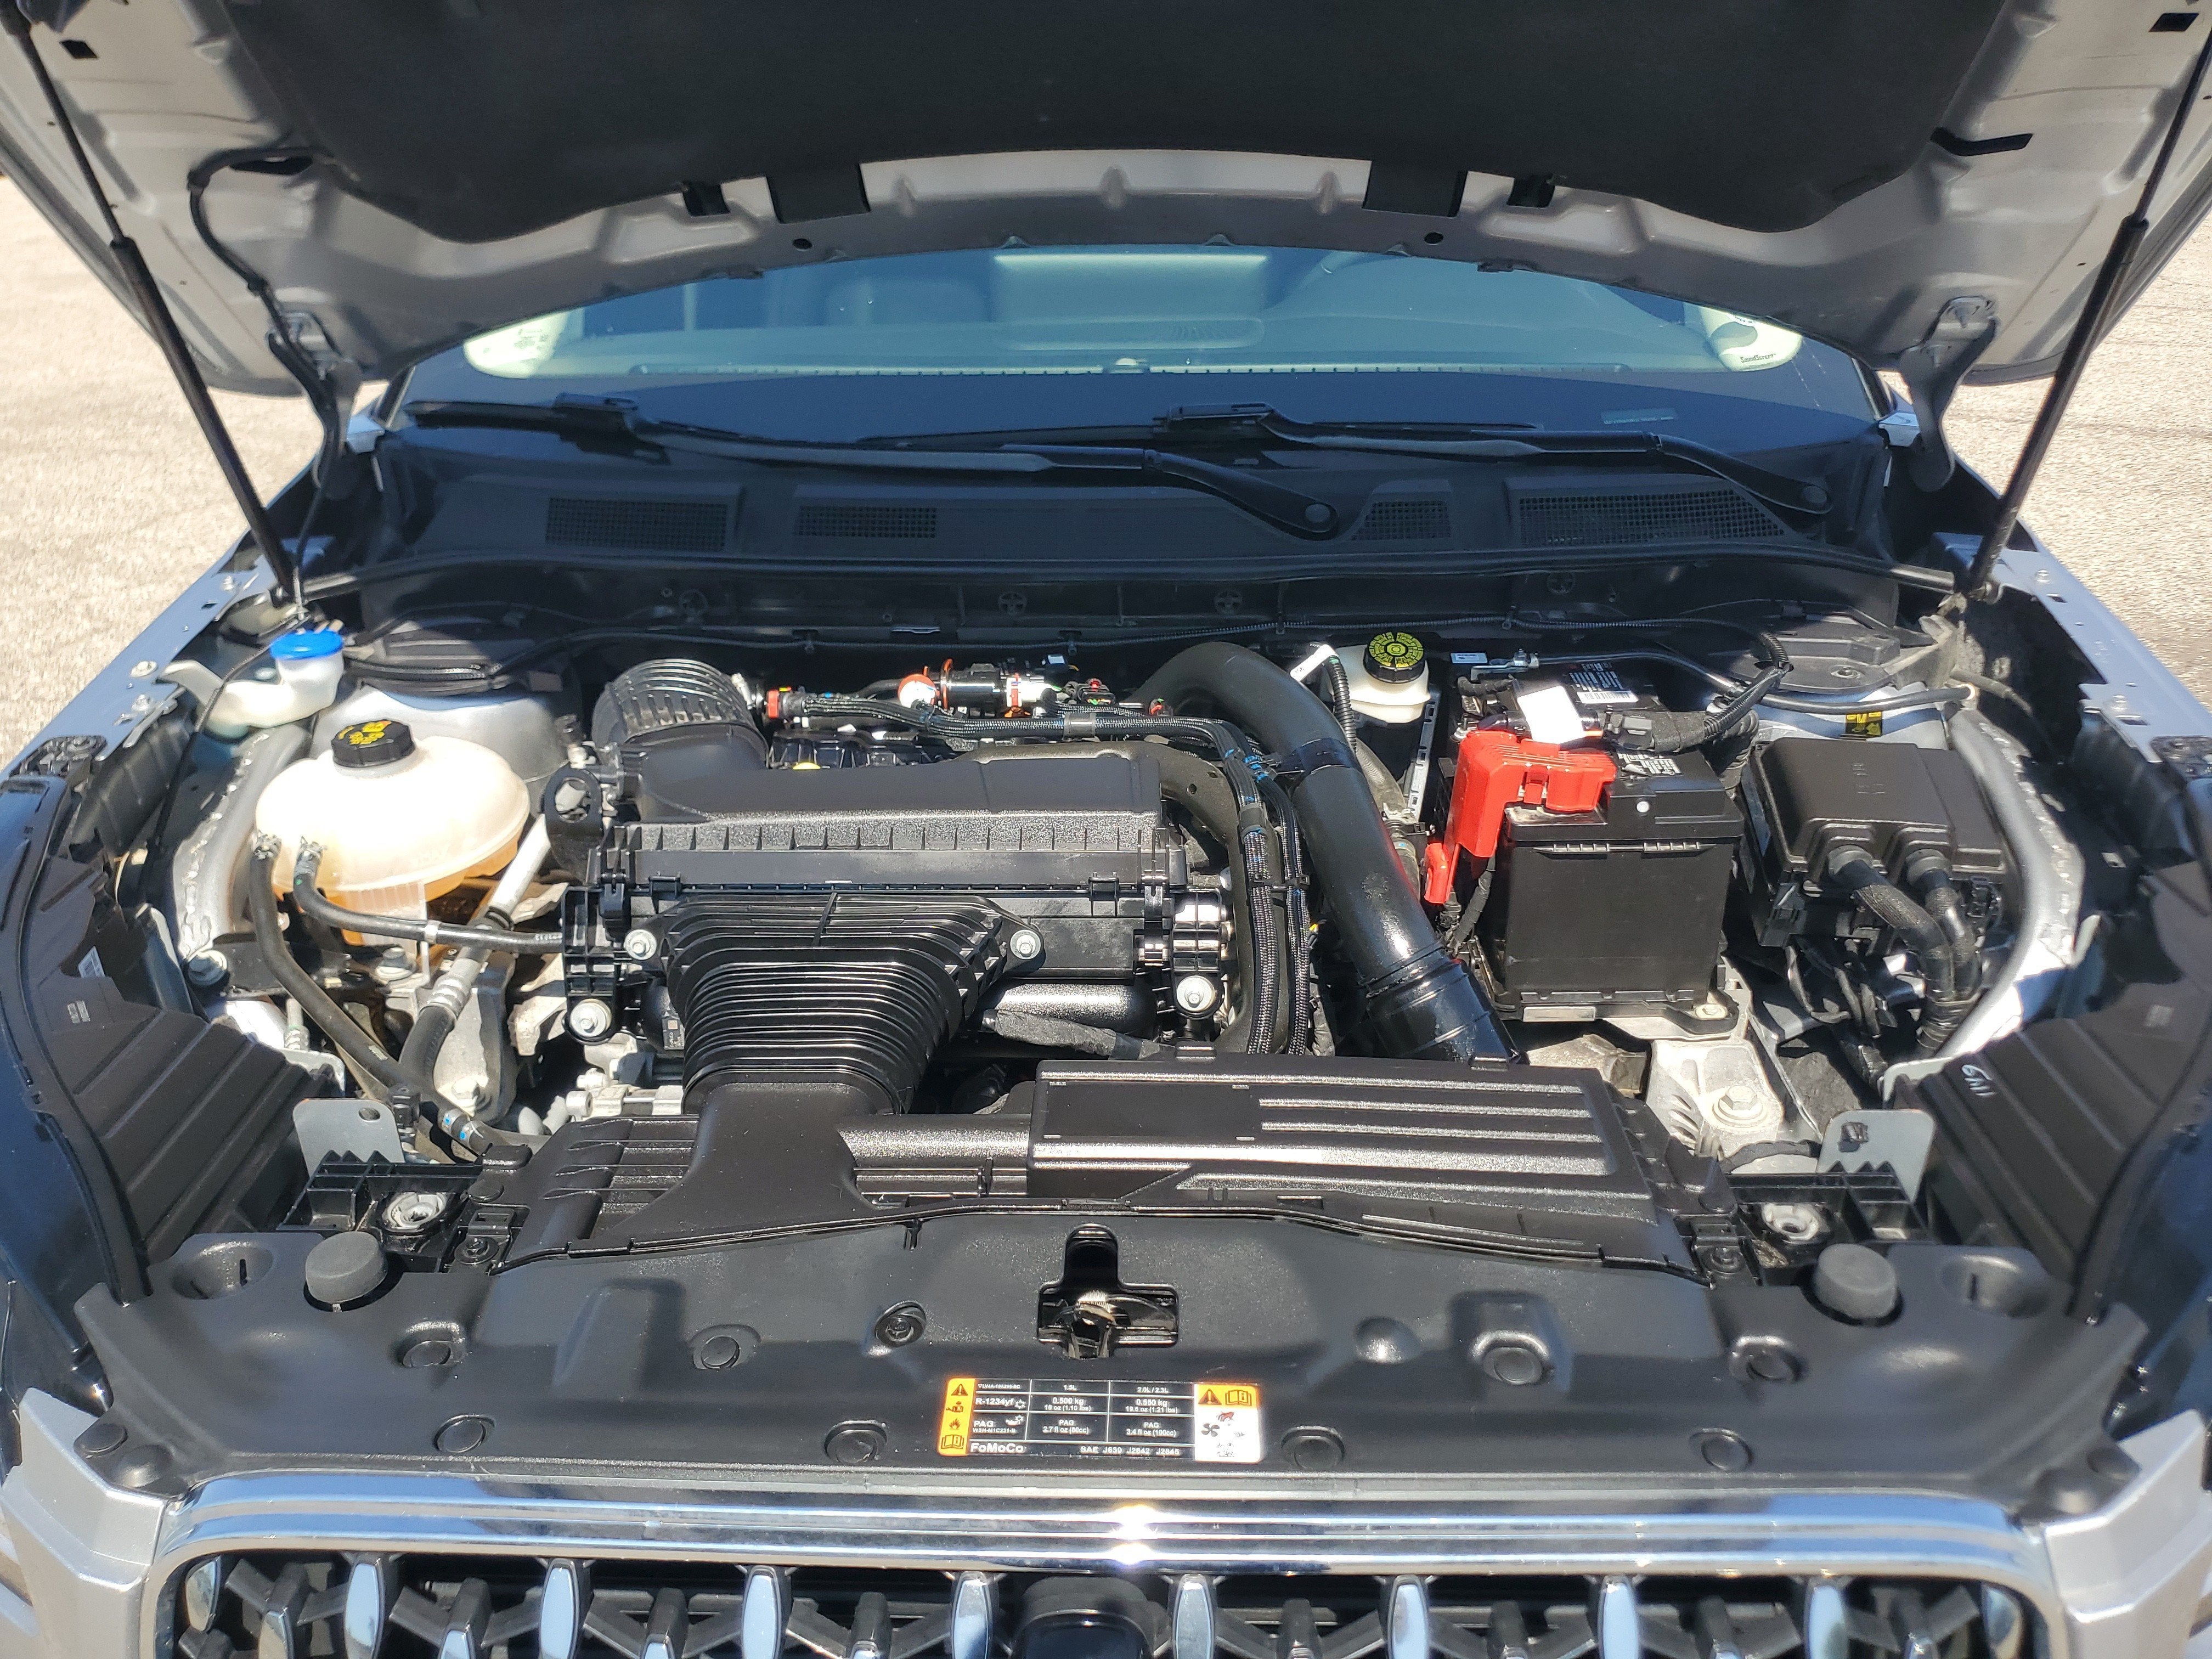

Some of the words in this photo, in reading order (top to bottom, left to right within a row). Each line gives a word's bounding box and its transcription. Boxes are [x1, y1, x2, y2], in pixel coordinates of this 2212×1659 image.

[975, 1398, 1014, 1407] R-1234yf
[1158, 1399, 1167, 1408] kg
[1153, 1429, 1176, 1437] (100cc)
[970, 1442, 1024, 1453] FoMoCo
